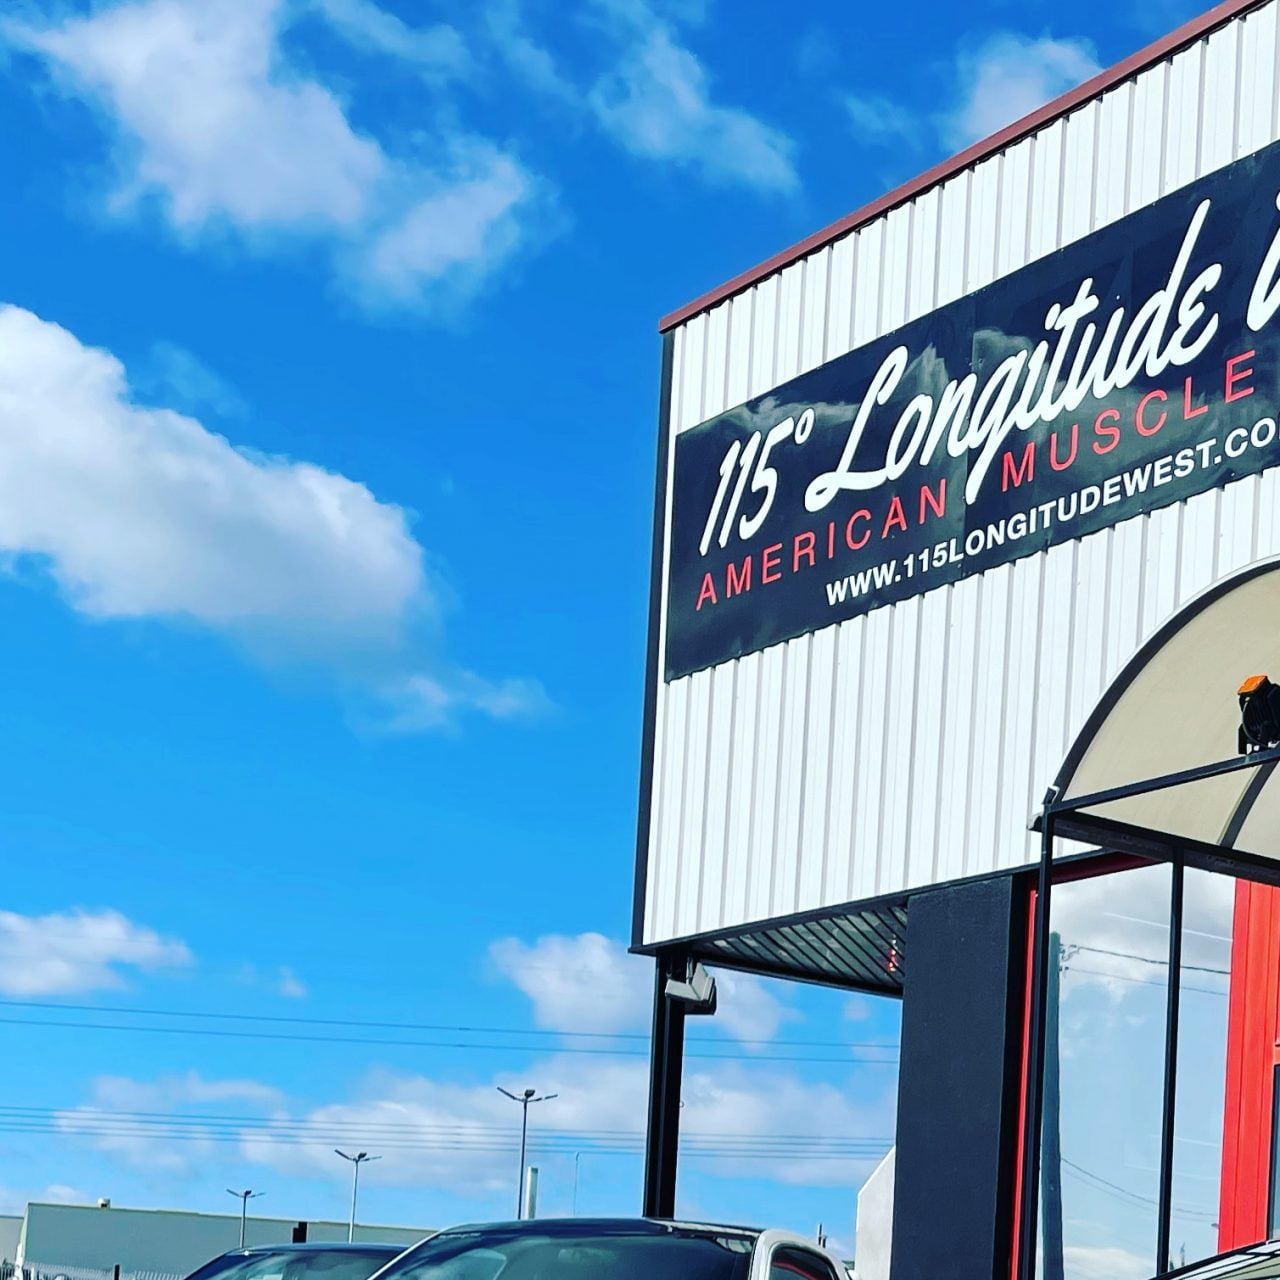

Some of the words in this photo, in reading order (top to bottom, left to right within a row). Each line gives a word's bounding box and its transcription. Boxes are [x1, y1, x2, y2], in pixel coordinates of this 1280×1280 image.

[695, 479, 947, 612] AMERICAN
[1001, 350, 1256, 492] MUSCLE
[804, 199, 1223, 512] Longitude
